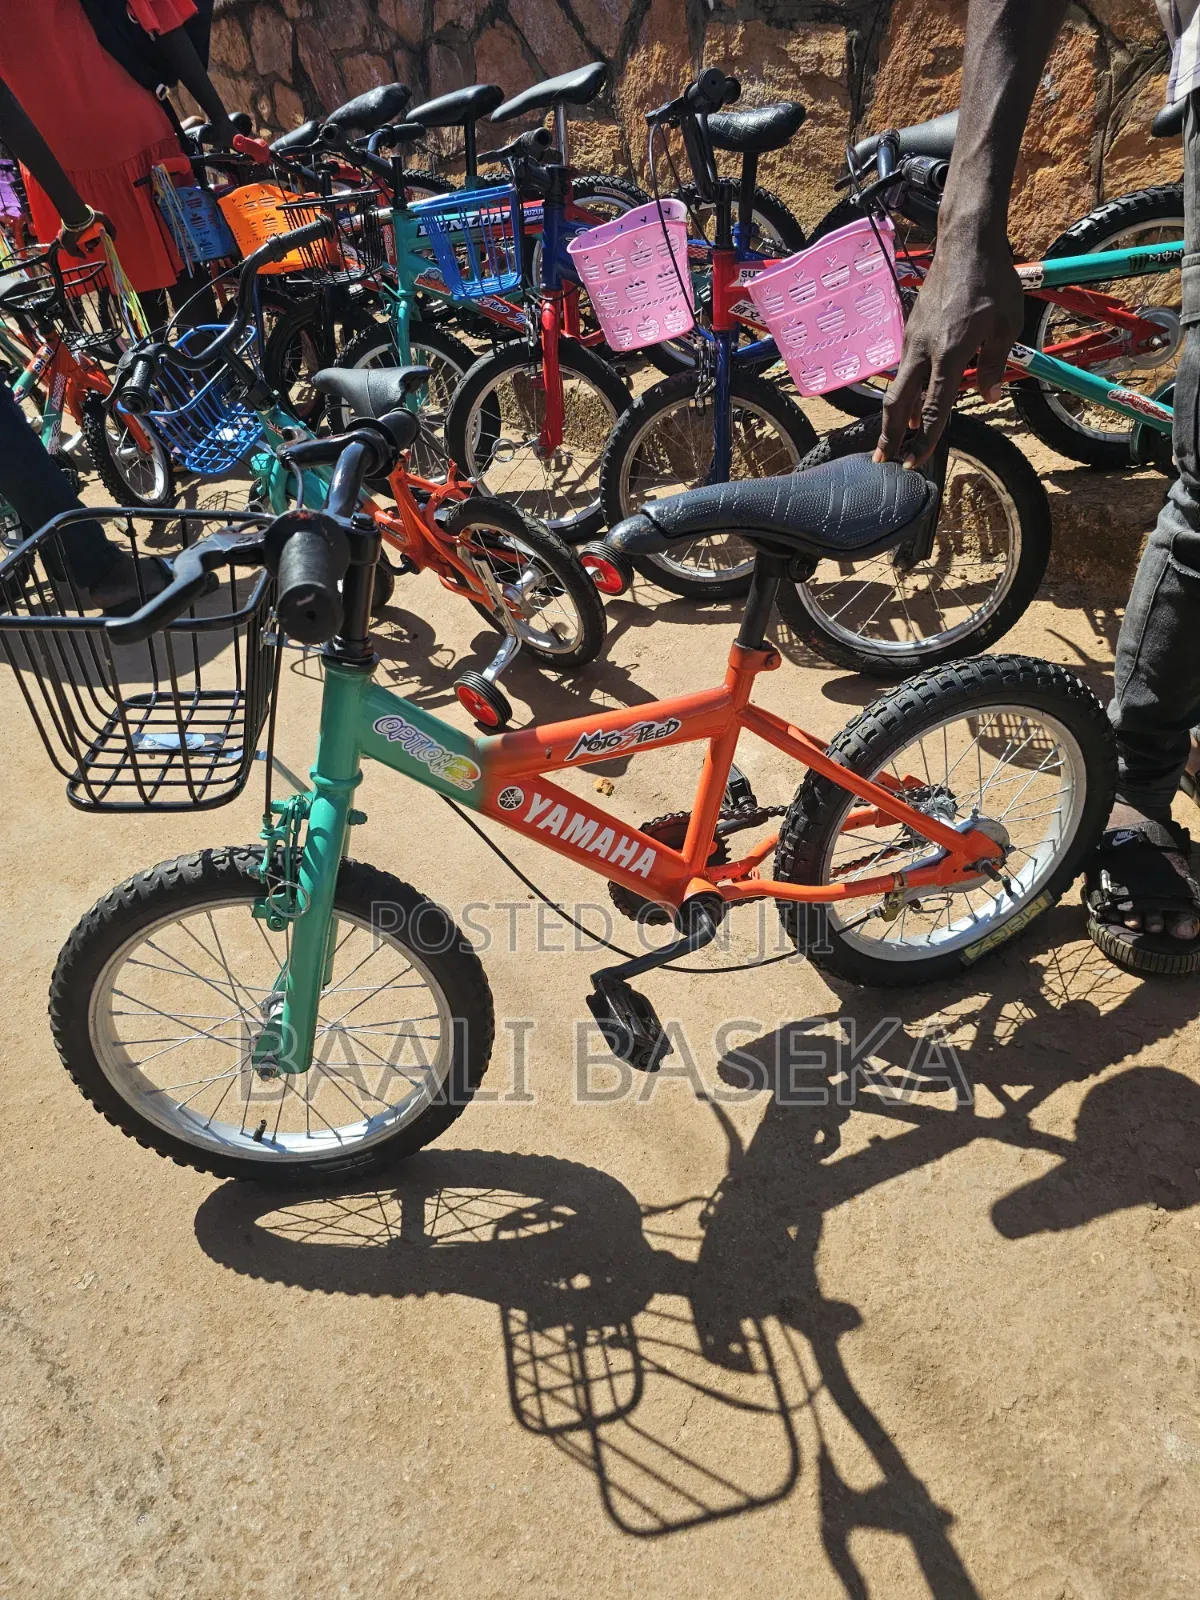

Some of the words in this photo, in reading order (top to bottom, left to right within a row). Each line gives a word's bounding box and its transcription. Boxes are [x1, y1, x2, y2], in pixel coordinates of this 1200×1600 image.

[523, 207, 544, 217] SUZU
[374, 717, 458, 768] OPTION
[523, 792, 657, 879] YAMAHA
[1115, 831, 1134, 839] NIKE
